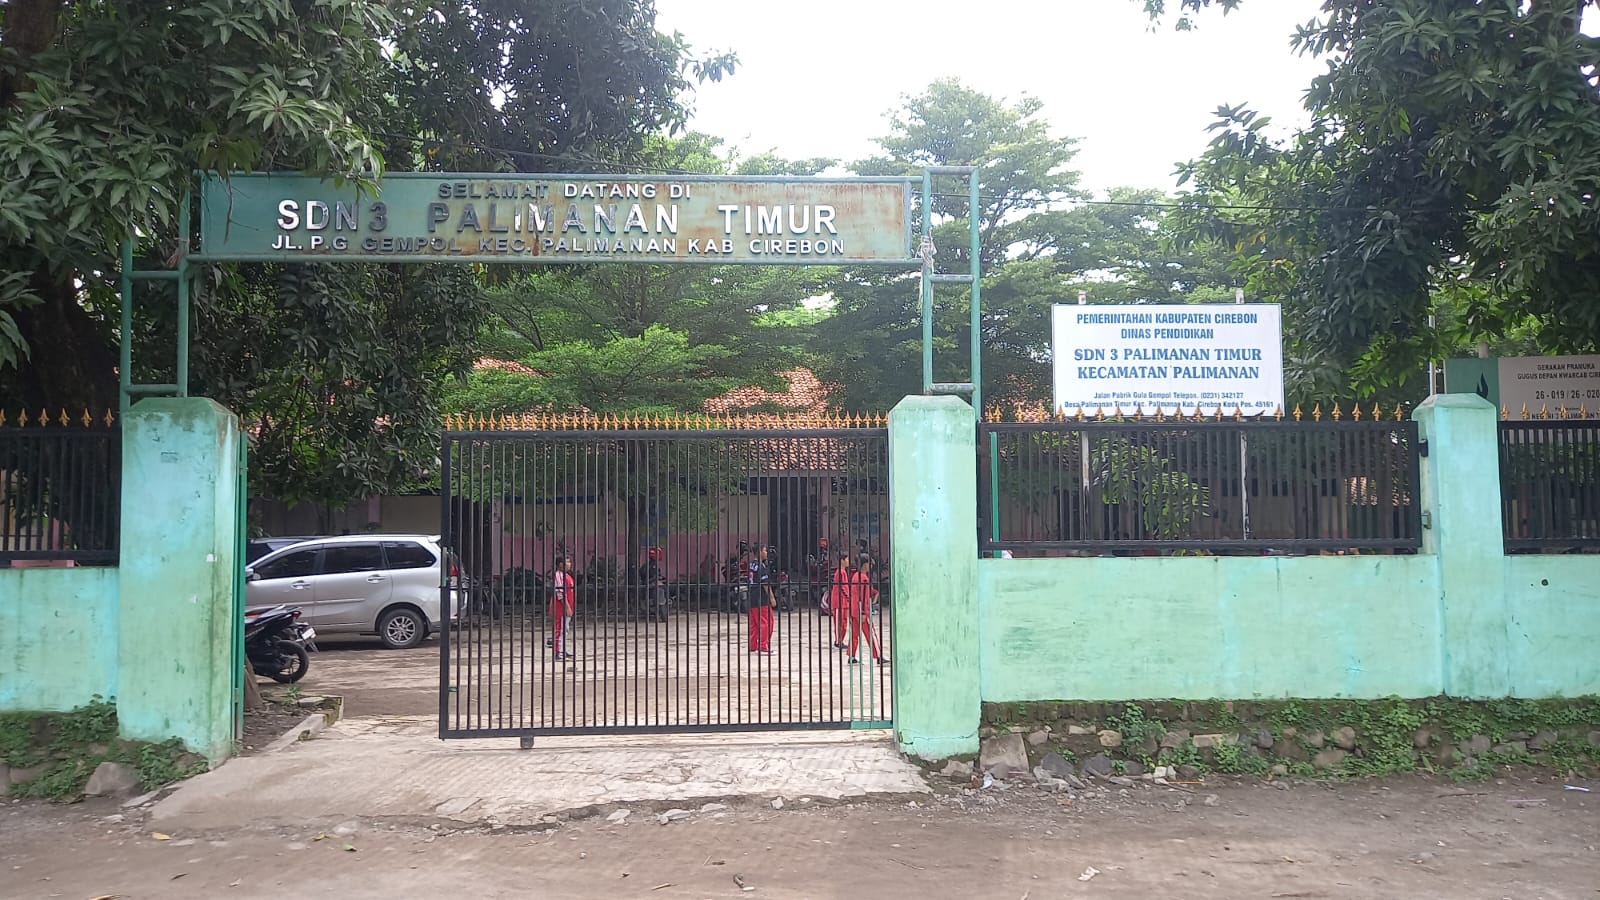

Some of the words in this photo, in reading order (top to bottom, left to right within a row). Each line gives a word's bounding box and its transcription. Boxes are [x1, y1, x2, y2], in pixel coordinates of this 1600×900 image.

[439, 182, 549, 199] SELAMAT
[564, 182, 656, 199] DATANG
[670, 183, 691, 199] DI
[276, 199, 359, 233] SDN
[368, 201, 388, 232] 3
[427, 201, 679, 234] PALIMANAN
[718, 203, 838, 235] TIMUR
[271, 234, 303, 250] JL.
[310, 235, 349, 251] P.G
[362, 236, 462, 252] GEMPOL
[479, 237, 532, 253] KEC.
[541, 237, 676, 254] PALIMANAN
[688, 238, 735, 255] KAB
[749, 238, 845, 255] CIREBON
[1077, 313, 1152, 325] PEMERINTAHAN
[1155, 313, 1212, 324] KABUPATEN
[1214, 313, 1258, 324] CIREBON
[1121, 328, 1152, 339] DINAS
[1154, 328, 1214, 339] PENDIDIKAN
[1074, 348, 1105, 361] SDN
[1110, 348, 1119, 361] 3
[1123, 348, 1210, 361] PALIMANAN
[1214, 348, 1262, 361] TIMUR
[1077, 366, 1168, 379] KECAMATAN
[1172, 366, 1259, 379] PALIMANAN
